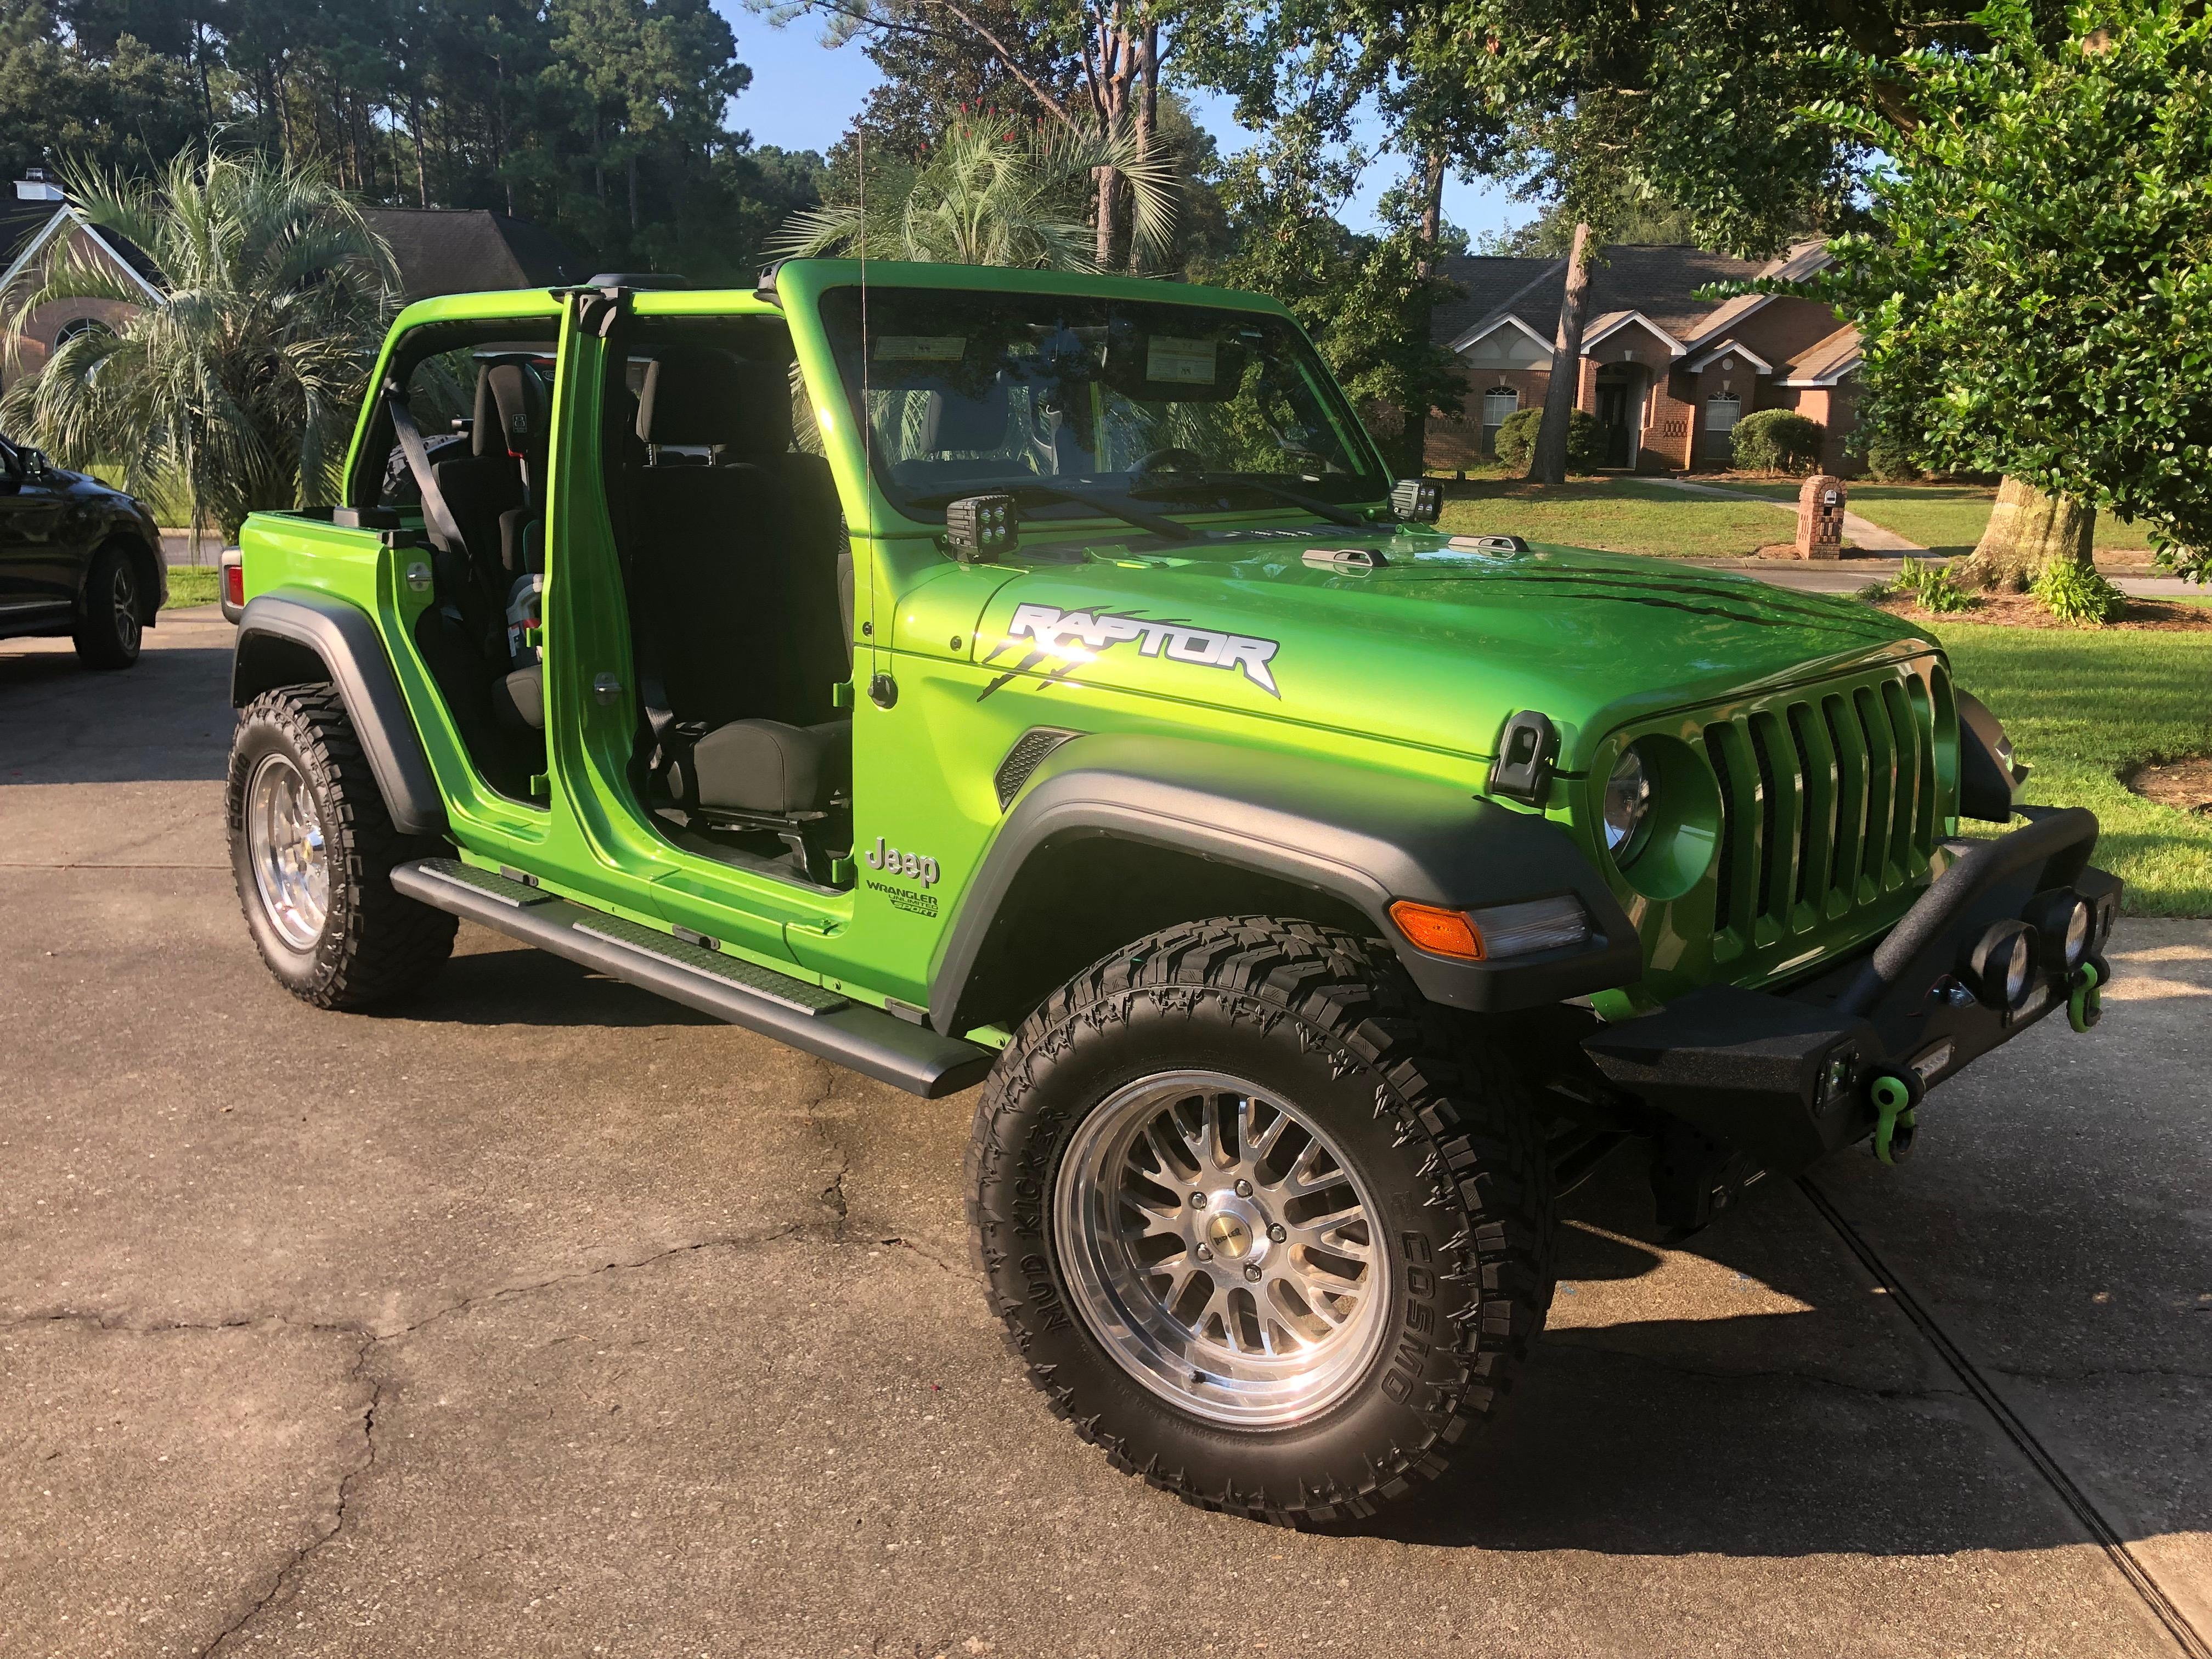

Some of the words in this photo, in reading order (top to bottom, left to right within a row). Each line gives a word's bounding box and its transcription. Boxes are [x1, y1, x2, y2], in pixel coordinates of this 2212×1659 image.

[1008, 602, 1282, 701] RAPTOR
[865, 836, 940, 889] Jeep
[866, 879, 938, 905] WRANGLER
[888, 894, 939, 910] UNLIMITED
[891, 901, 938, 918] SPORT
[1012, 1105, 1072, 1239] KICKER
[1213, 1227, 1243, 1245] RIDLER
[1019, 1252, 1071, 1331] MUD
[1381, 1230, 1436, 1406] COSMO
